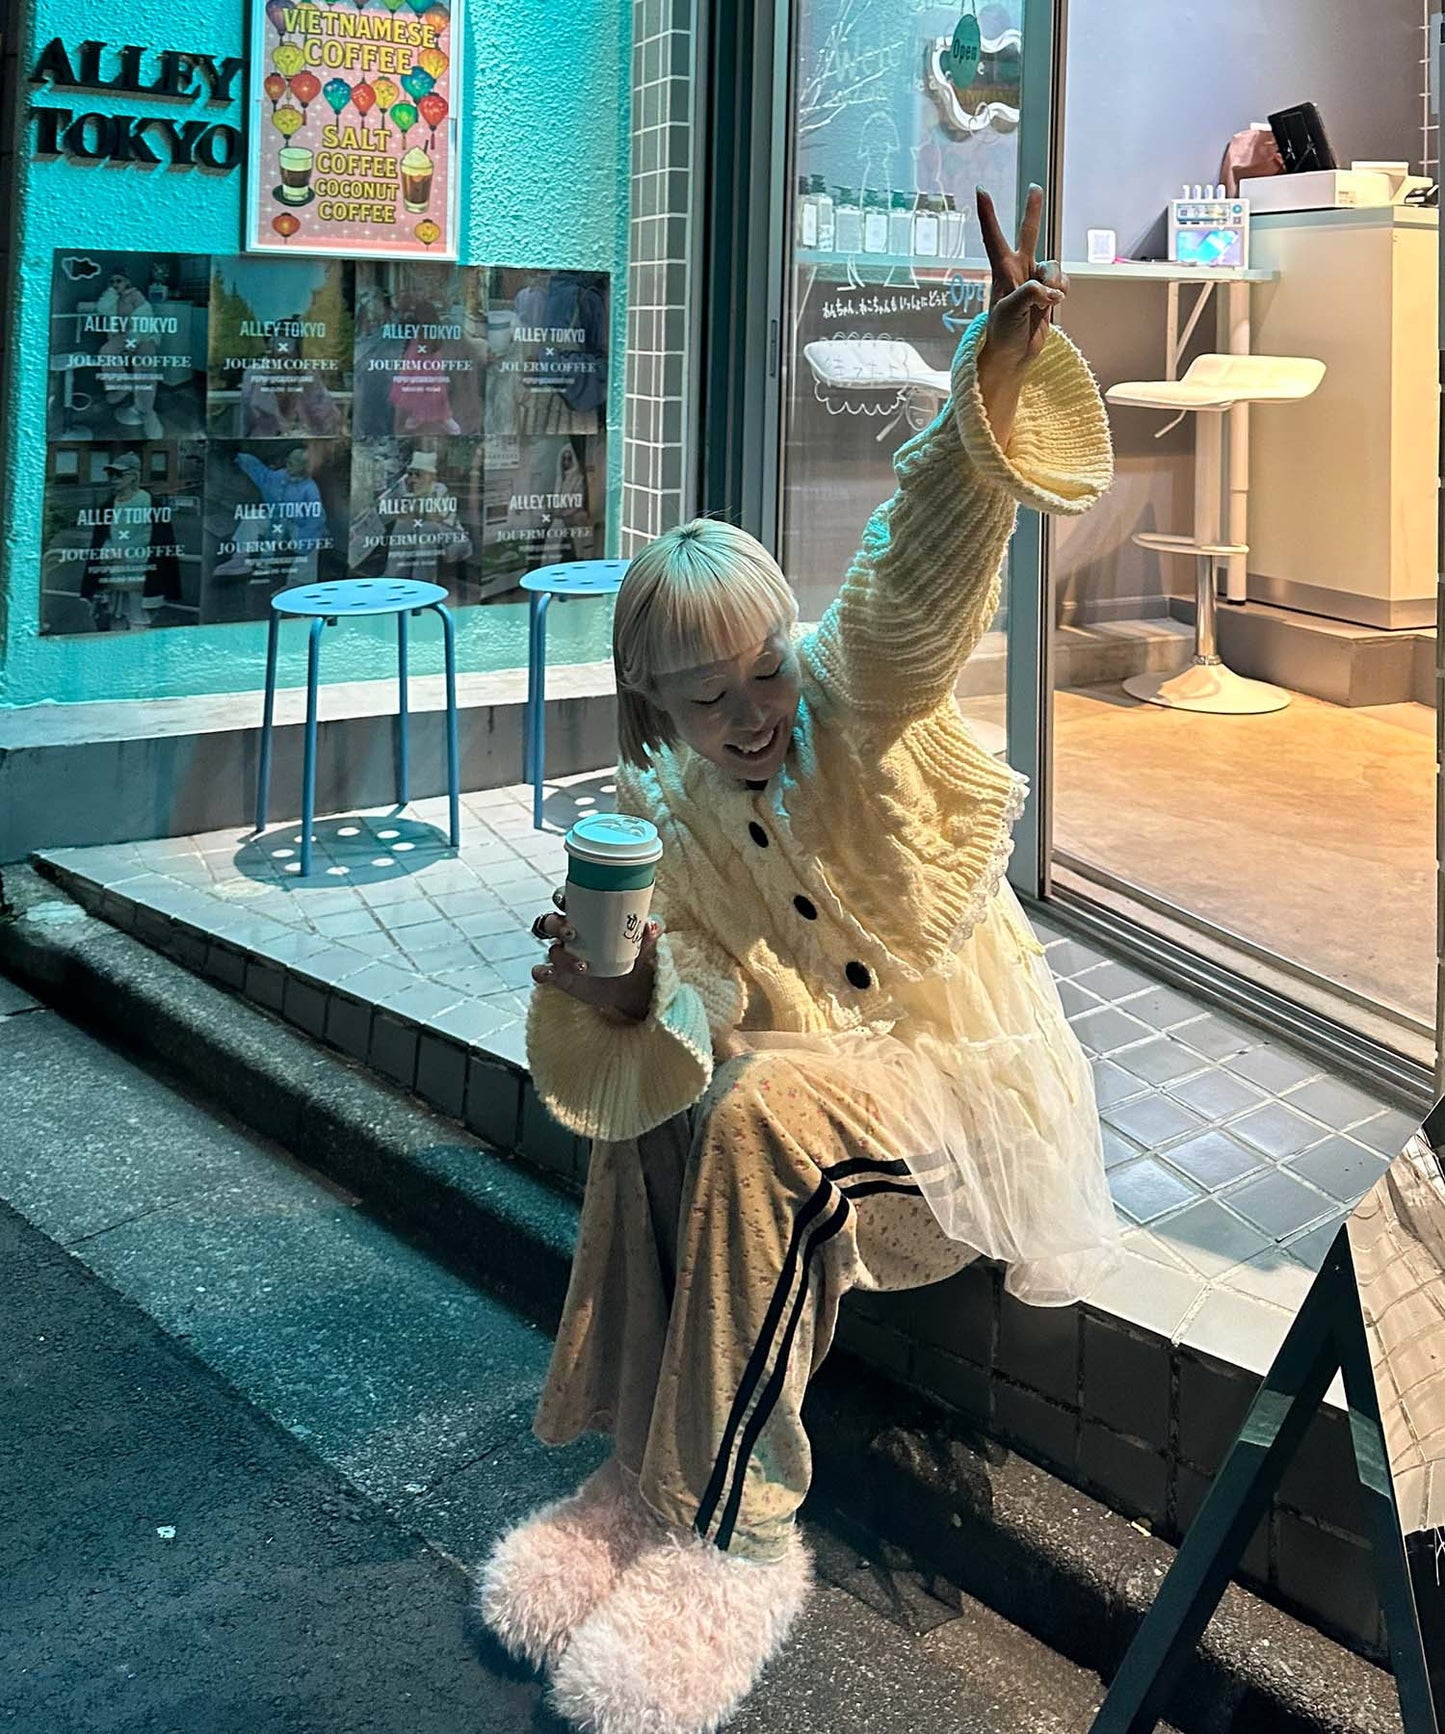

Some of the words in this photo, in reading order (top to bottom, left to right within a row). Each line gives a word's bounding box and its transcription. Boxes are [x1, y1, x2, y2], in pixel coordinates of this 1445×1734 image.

[282, 7, 437, 48] VIETNAMESE
[304, 38, 413, 75] COFFEE
[952, 38, 978, 64] Open
[28, 37, 244, 102] ALLEY
[29, 106, 242, 170] TOKYO
[323, 124, 391, 152] SALT
[316, 152, 398, 179] COFFEE
[315, 178, 399, 200] COCONUT
[317, 201, 396, 224] COFFEE
[84, 316, 128, 333] ALLEY
[131, 317, 178, 333] TOKYO
[239, 321, 279, 337] ALLEY
[284, 321, 326, 338] TOKYO
[382, 324, 420, 340] ALLEY
[423, 324, 461, 340] TOKYO
[513, 328, 548, 343] ALLEY
[550, 328, 585, 343] TOKYO
[131, 355, 192, 368] COFFEE
[284, 358, 339, 371] COFFEE
[423, 359, 472, 371] COFFEE
[550, 361, 596, 373] COFFEE
[234, 503, 274, 520] ALLEY
[279, 502, 321, 518] TOKYO
[378, 498, 417, 515] ALLEY
[419, 497, 457, 513] TOKYO
[509, 494, 545, 511] ALLEY
[546, 493, 582, 508] TOKYO
[77, 508, 121, 526] ALLEY
[124, 507, 171, 524] TOKYO
[418, 531, 470, 545] COFFEE
[546, 527, 593, 540] COFFEE
[124, 545, 185, 560] COFFEE
[278, 538, 334, 552] COFFEE
